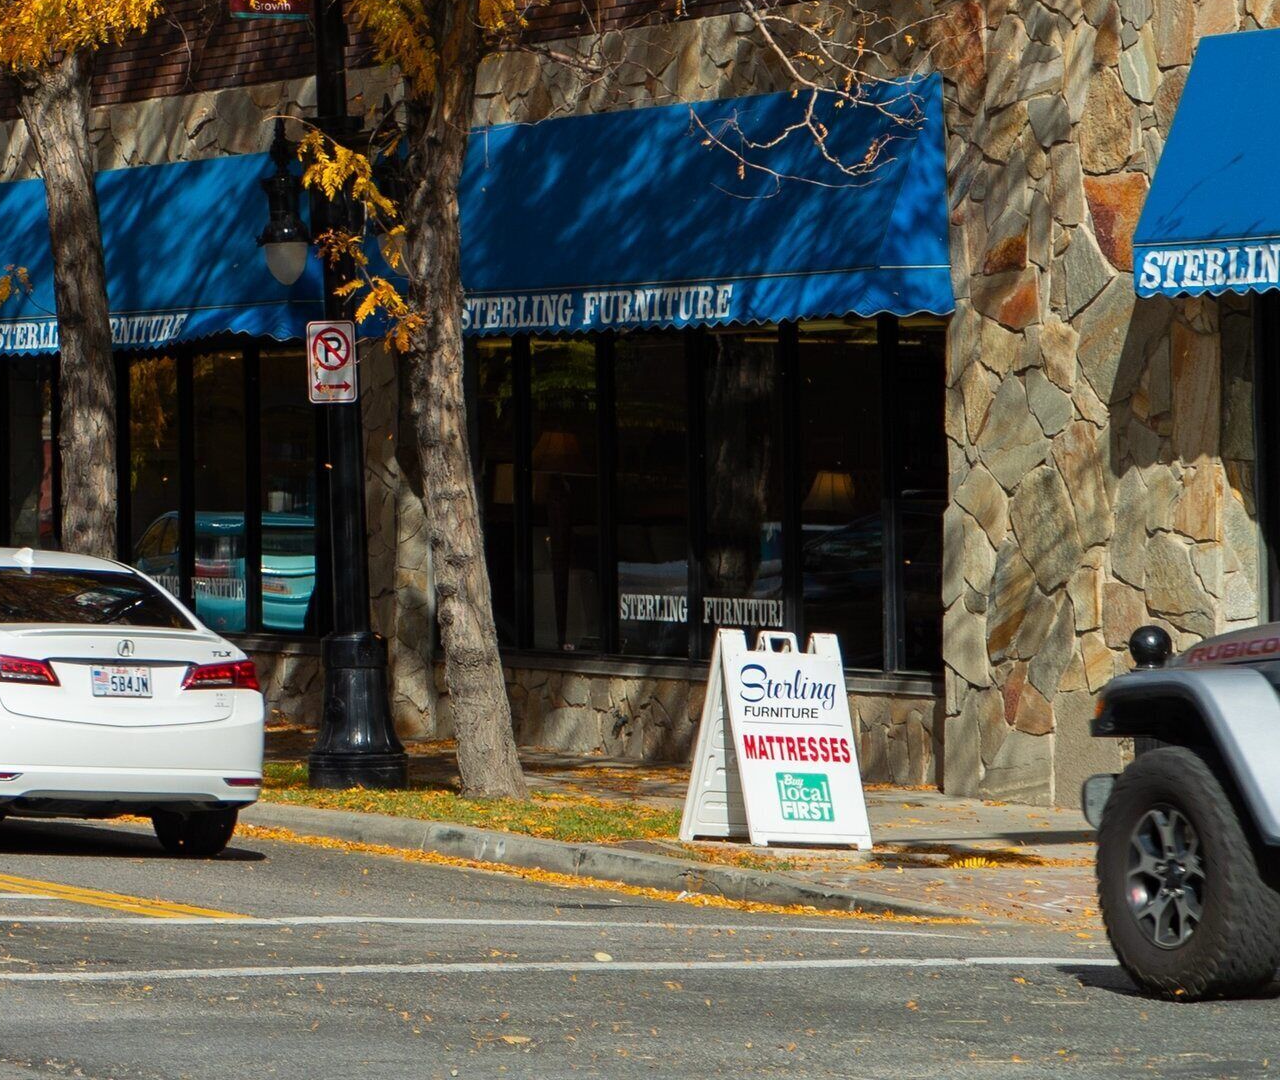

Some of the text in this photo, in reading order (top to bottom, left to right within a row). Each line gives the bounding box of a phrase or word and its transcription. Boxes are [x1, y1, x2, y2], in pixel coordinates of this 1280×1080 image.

[254, 1, 291, 11] Growth
[1139, 244, 1280, 289] STERLIN
[461, 284, 734, 329] STERLING FURNITURE
[110, 313, 189, 344] RNITURE
[620, 593, 688, 622] STERLING
[740, 664, 836, 710] Sterling
[744, 706, 819, 719] FURNITURE
[743, 735, 851, 764] MATTRESSES
[779, 780, 830, 802] local
[783, 774, 804, 788] Buy
[782, 801, 832, 820] FIRST
